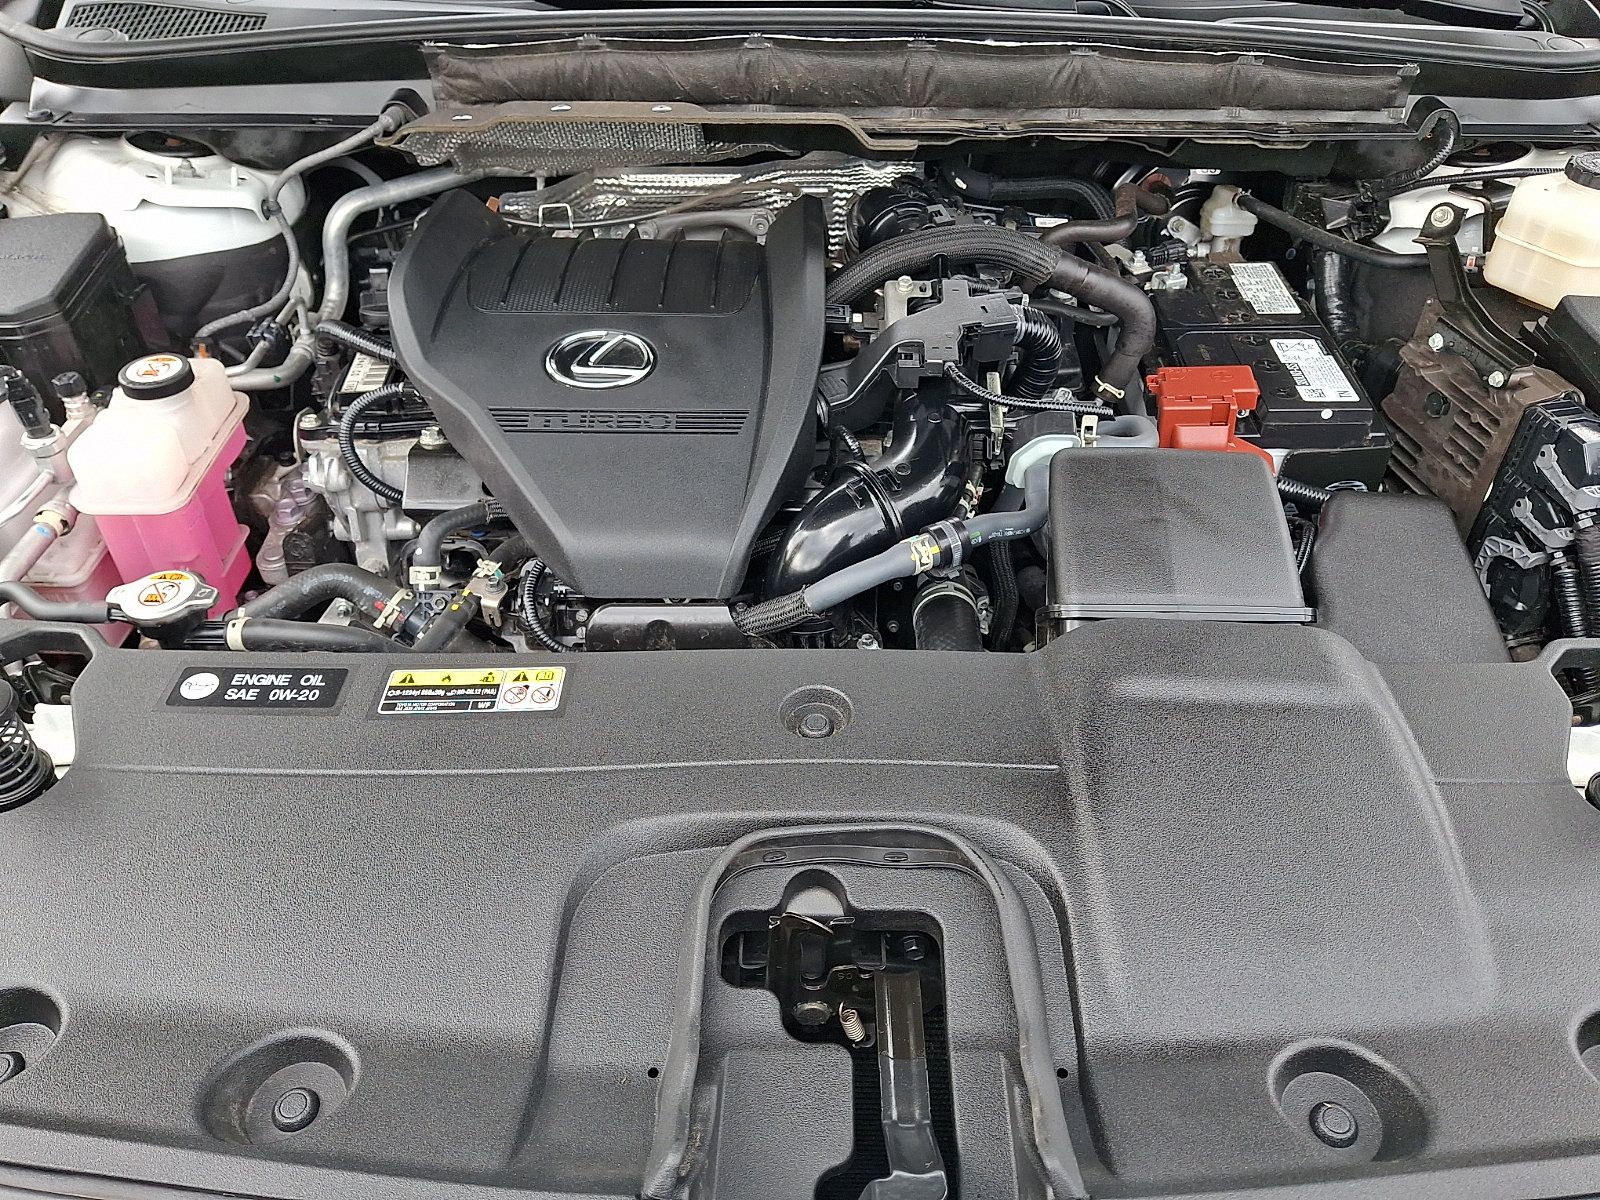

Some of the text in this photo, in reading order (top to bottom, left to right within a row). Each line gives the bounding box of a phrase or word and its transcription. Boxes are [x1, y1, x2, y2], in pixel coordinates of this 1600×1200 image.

[531, 412, 673, 430] TURBO
[230, 673, 326, 686] ENGINE OIL
[224, 688, 320, 701] SAE 0W-20
